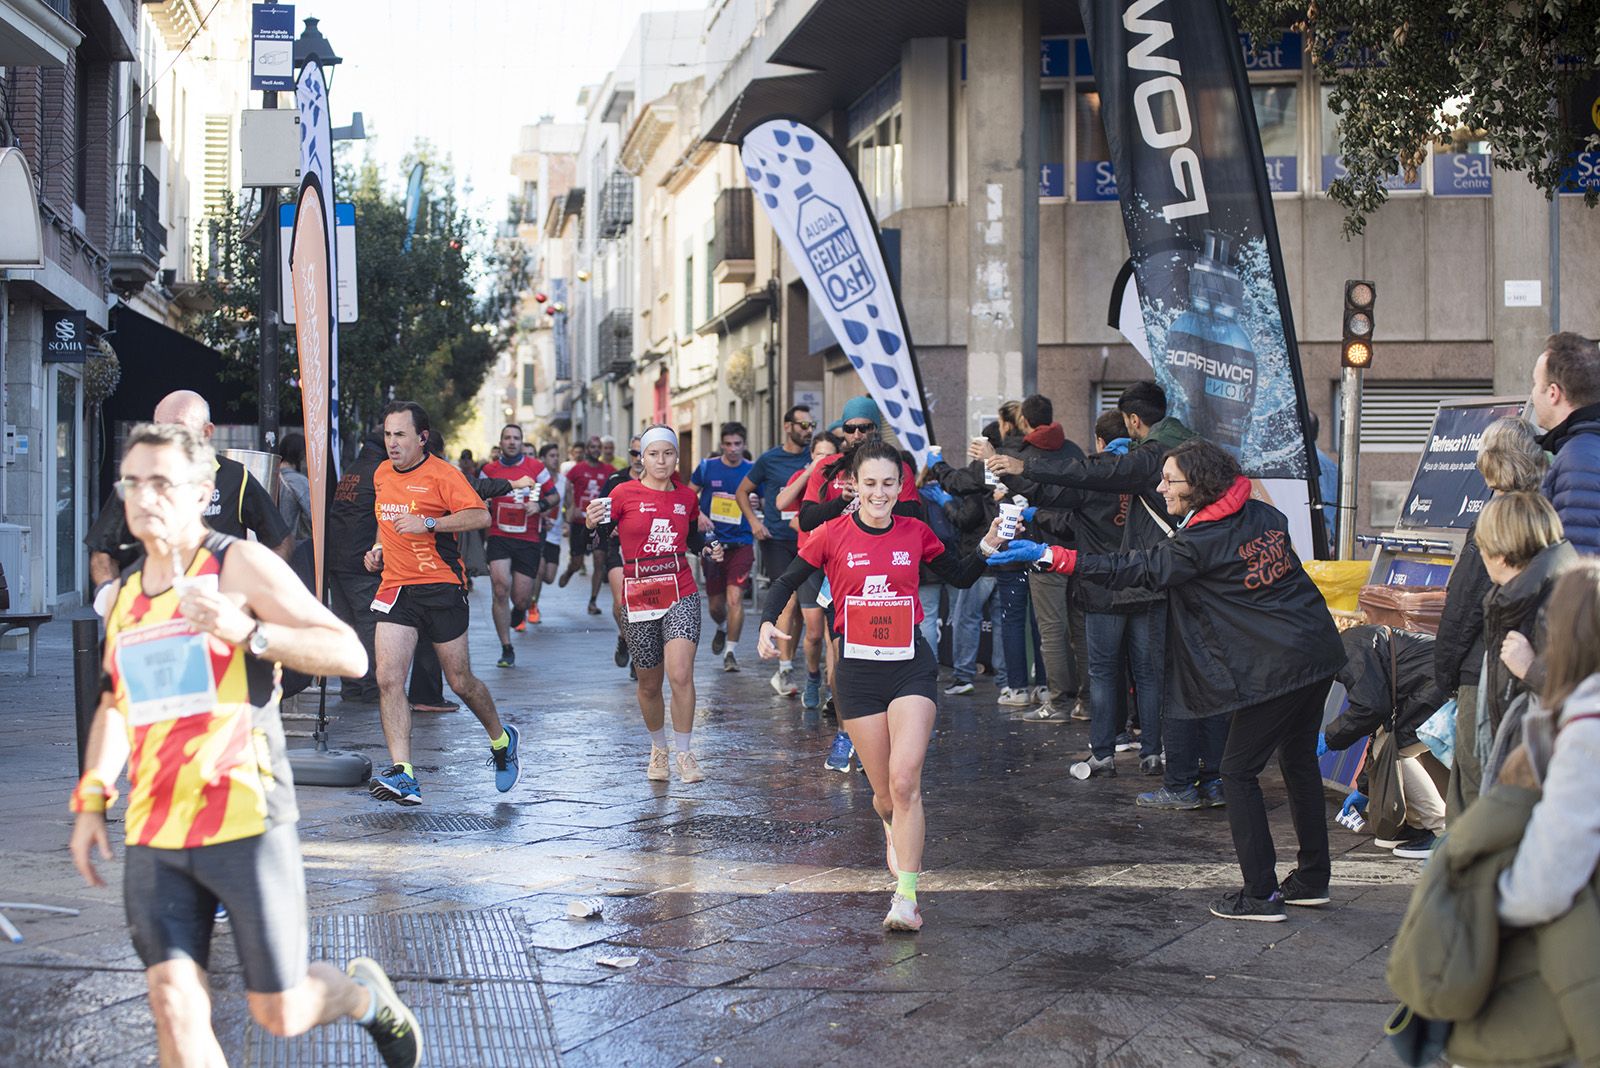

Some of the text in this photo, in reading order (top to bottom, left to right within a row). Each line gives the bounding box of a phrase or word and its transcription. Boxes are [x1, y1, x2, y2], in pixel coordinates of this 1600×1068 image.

[1454, 178, 1489, 189] Centre
[382, 502, 409, 513] MARATÓ
[654, 525, 673, 533] 21K
[648, 534, 677, 543] SANT
[643, 544, 678, 553] CUGAT
[410, 542, 438, 572] 2017
[639, 561, 676, 572] WONG
[868, 583, 891, 594] 21K
[869, 616, 892, 625] JOANA
[872, 628, 890, 640] 483
